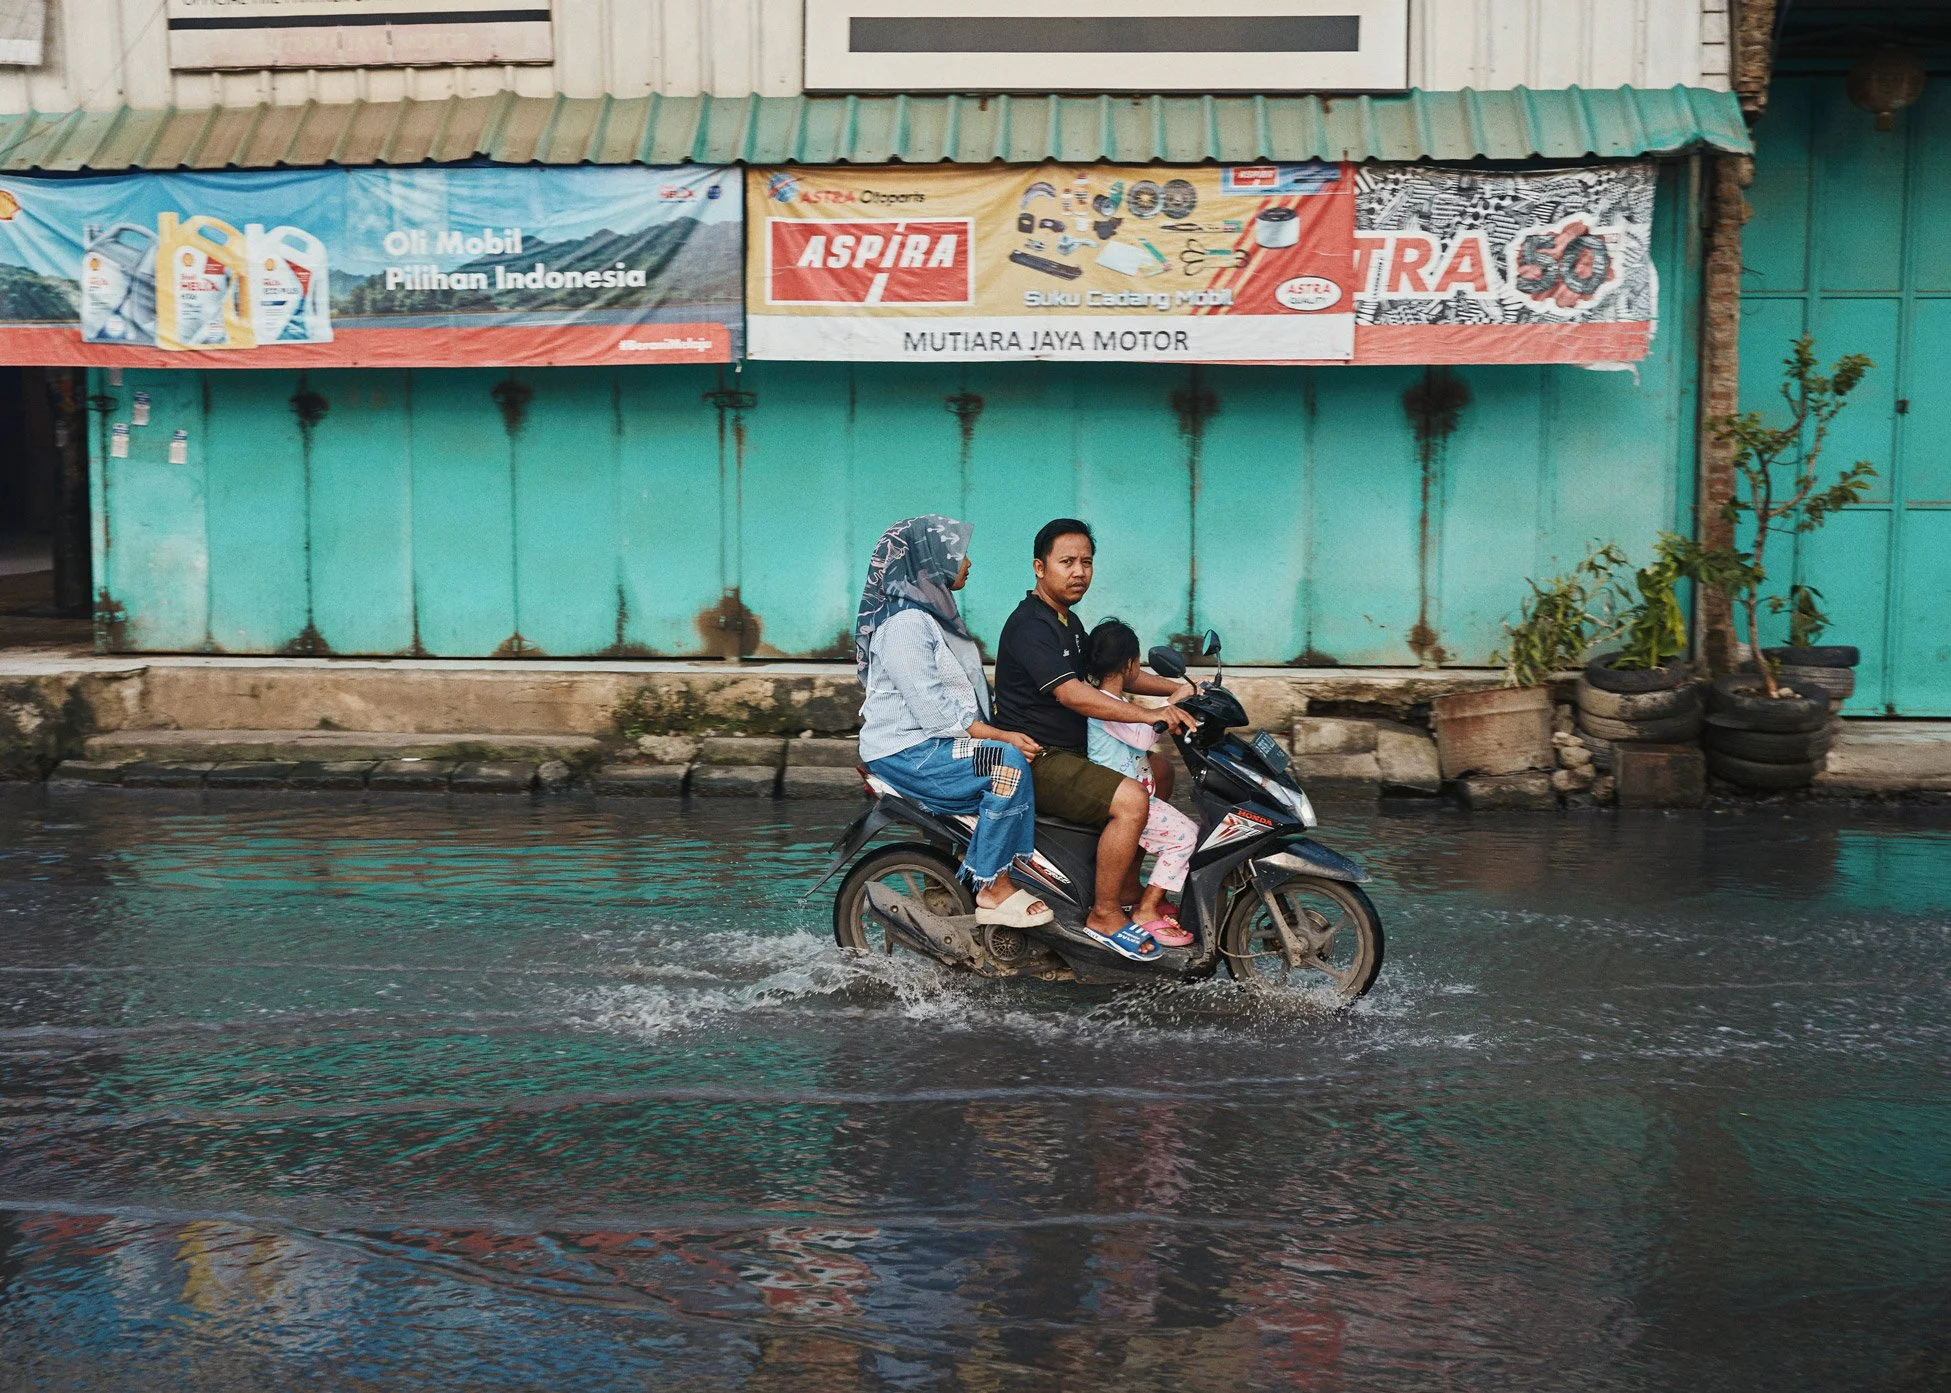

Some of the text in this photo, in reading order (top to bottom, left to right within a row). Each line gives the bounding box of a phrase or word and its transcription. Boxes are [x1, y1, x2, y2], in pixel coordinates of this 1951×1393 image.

[800, 190, 926, 207] ASTRA Otoparts
[384, 227, 523, 255] Oli Mobil
[796, 233, 958, 268] ASPIRA
[385, 262, 647, 291] Pilihan Indonesia
[1024, 288, 1234, 311] Suku Cadang Mobil
[1288, 283, 1331, 294] ASTRA
[903, 330, 1189, 351] MUTIARA JAYA MOTOR
[1236, 809, 1274, 827] HONDA
